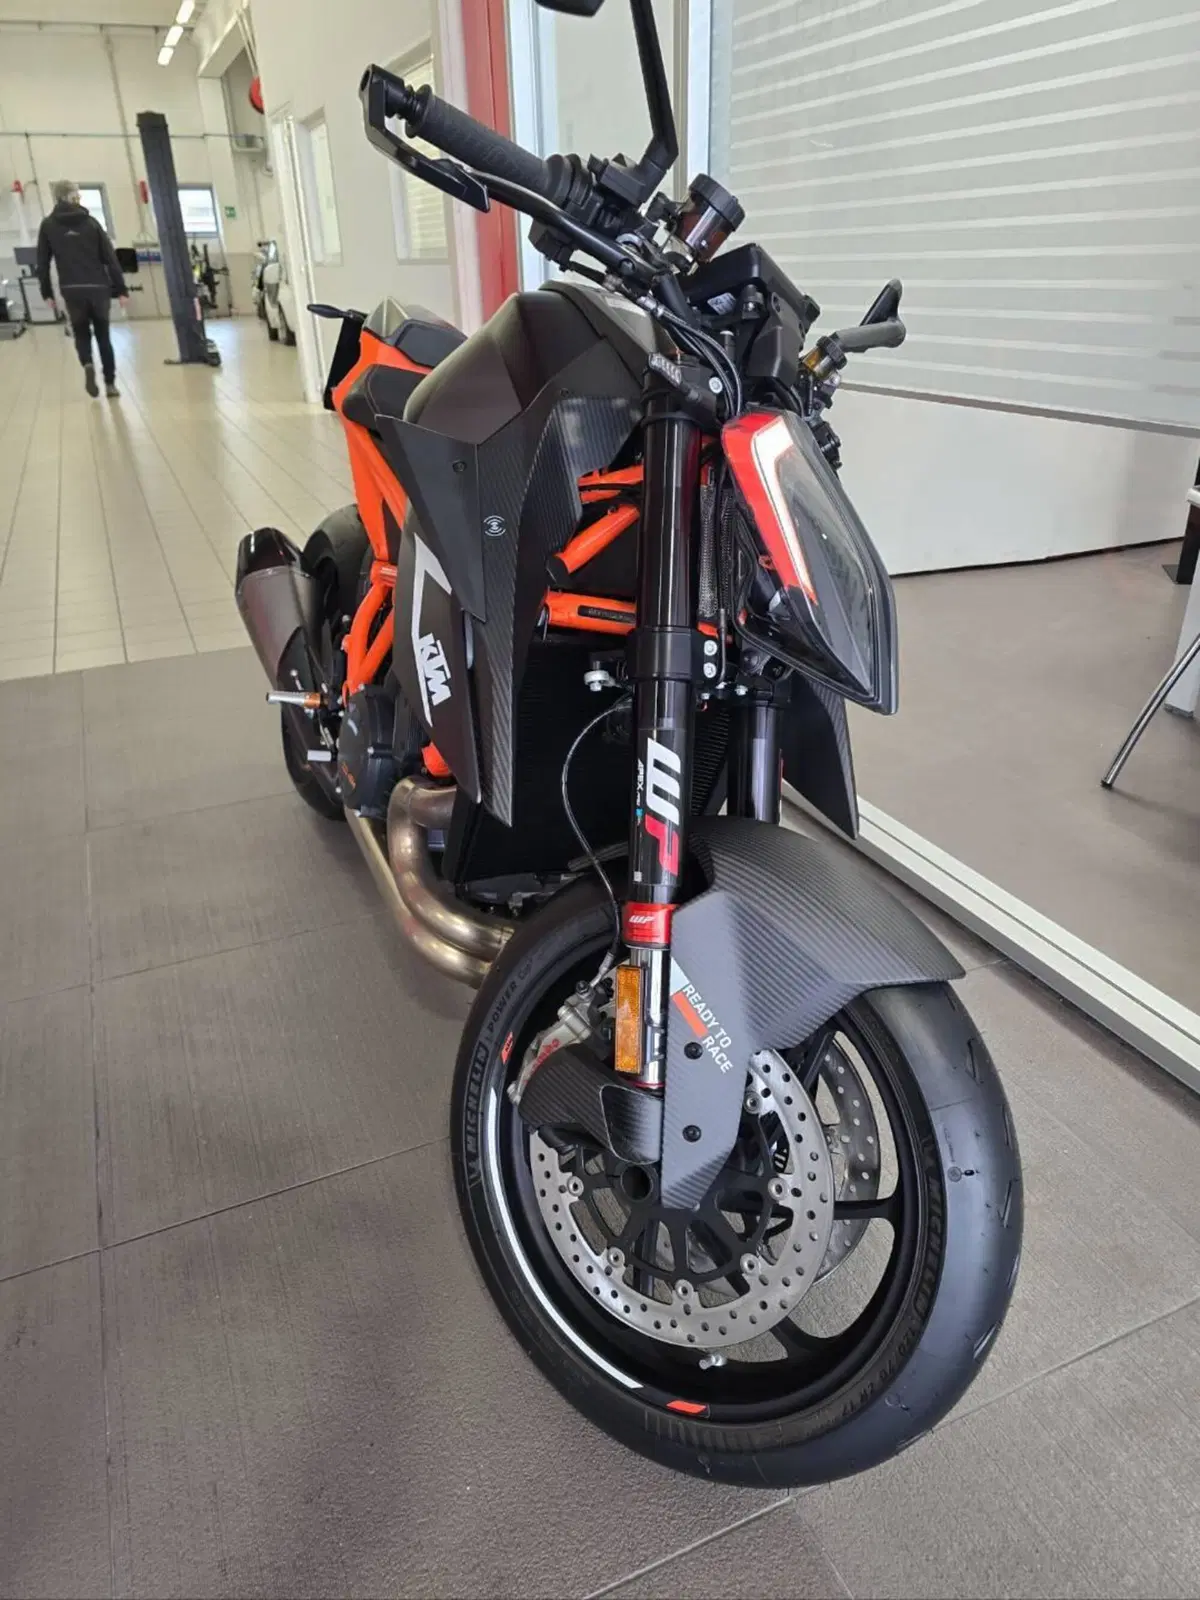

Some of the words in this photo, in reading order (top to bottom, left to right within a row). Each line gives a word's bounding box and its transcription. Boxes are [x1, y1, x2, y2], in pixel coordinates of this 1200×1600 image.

[419, 632, 452, 706] KTM
[682, 984, 720, 1029] READY
[714, 1027, 732, 1049] TO
[702, 1035, 734, 1074] RACE
[466, 1044, 488, 1154] MICHELIN
